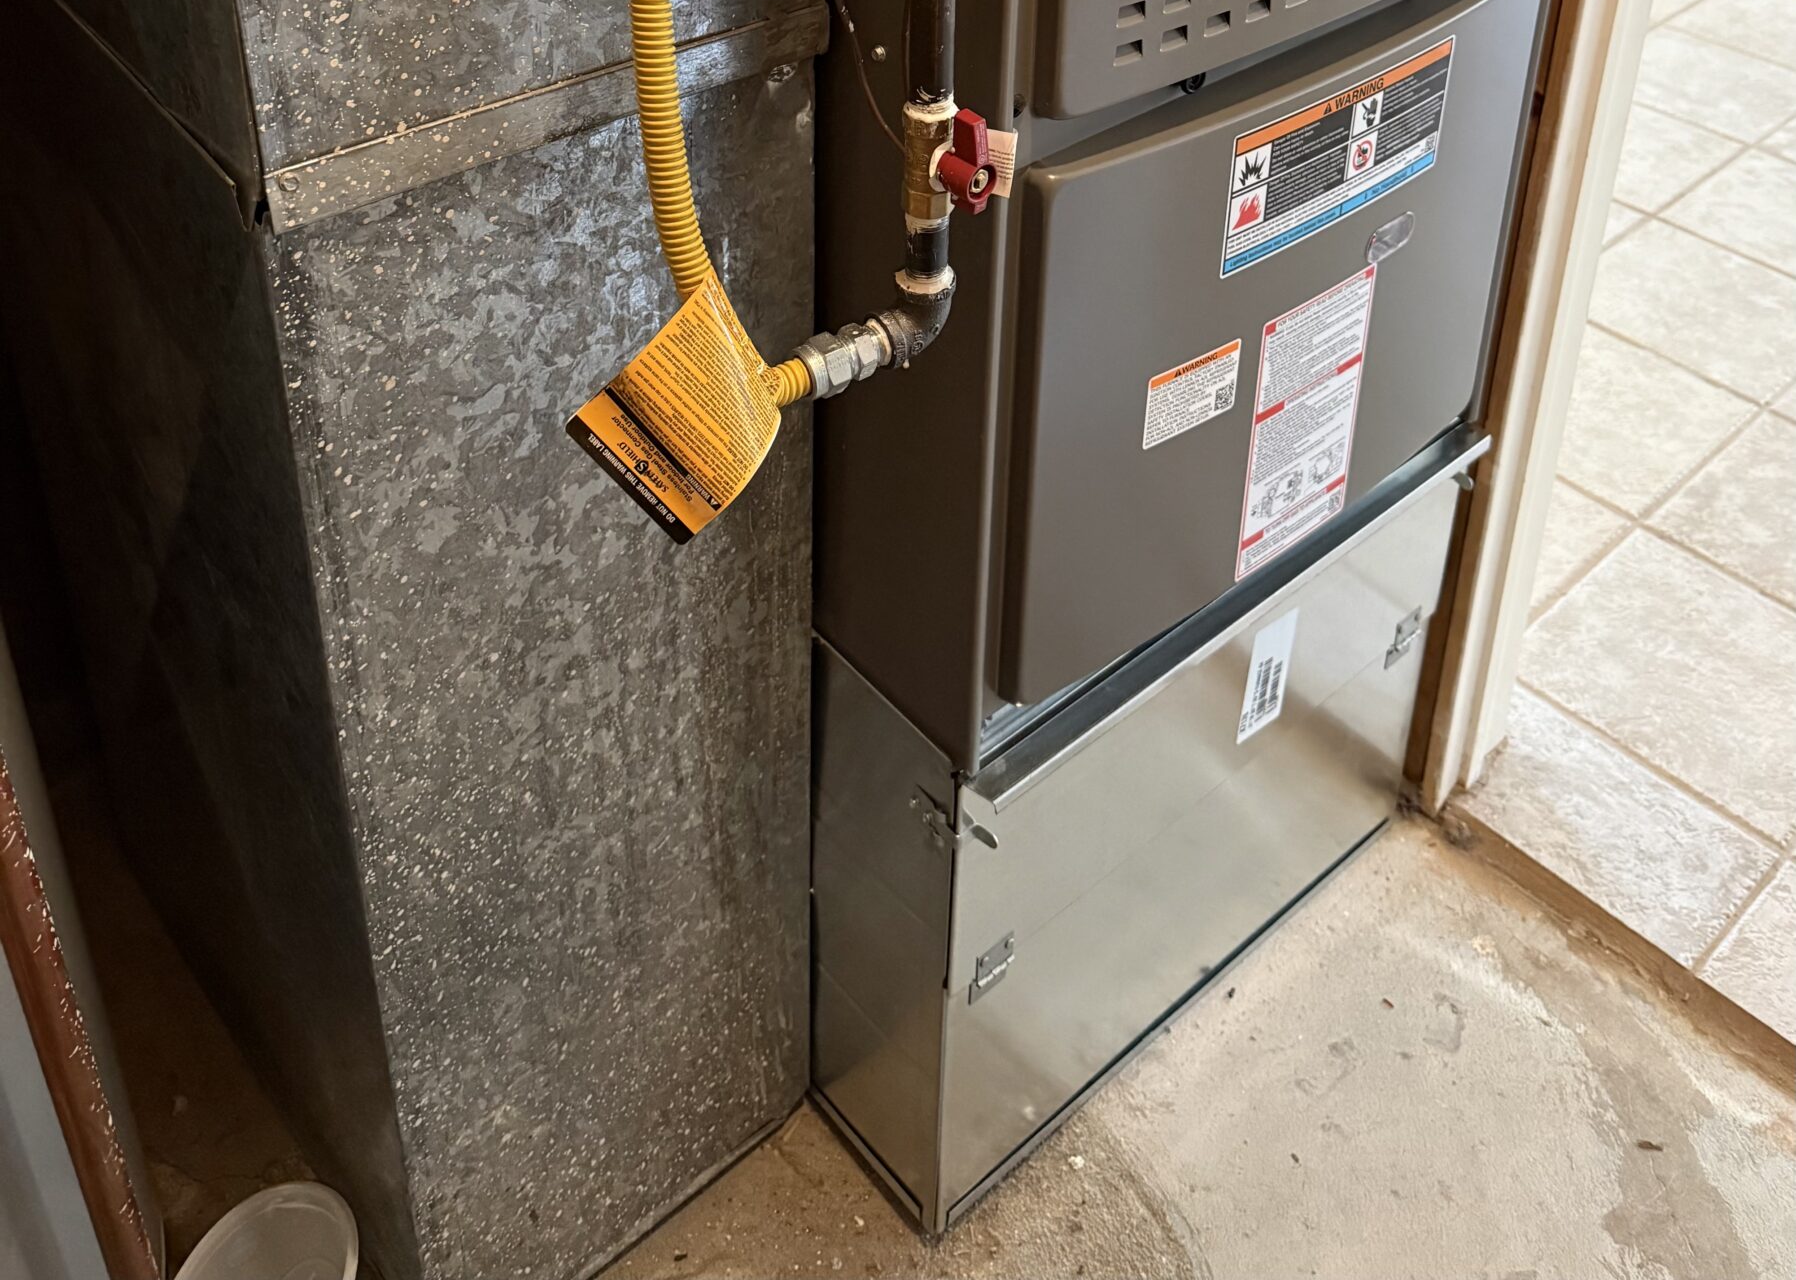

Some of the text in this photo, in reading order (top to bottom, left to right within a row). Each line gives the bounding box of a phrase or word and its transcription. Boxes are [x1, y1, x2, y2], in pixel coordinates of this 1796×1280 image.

[1334, 77, 1385, 110] WARNING
[1182, 352, 1219, 375] WARNING
[585, 431, 677, 524] DO NOT REMOVE THIS WARNING LABEL
[609, 414, 693, 502] Stainless Steel Gas Connector
[618, 413, 695, 495] For Indoor and Outdoor Use
[684, 472, 711, 500] WARNING
